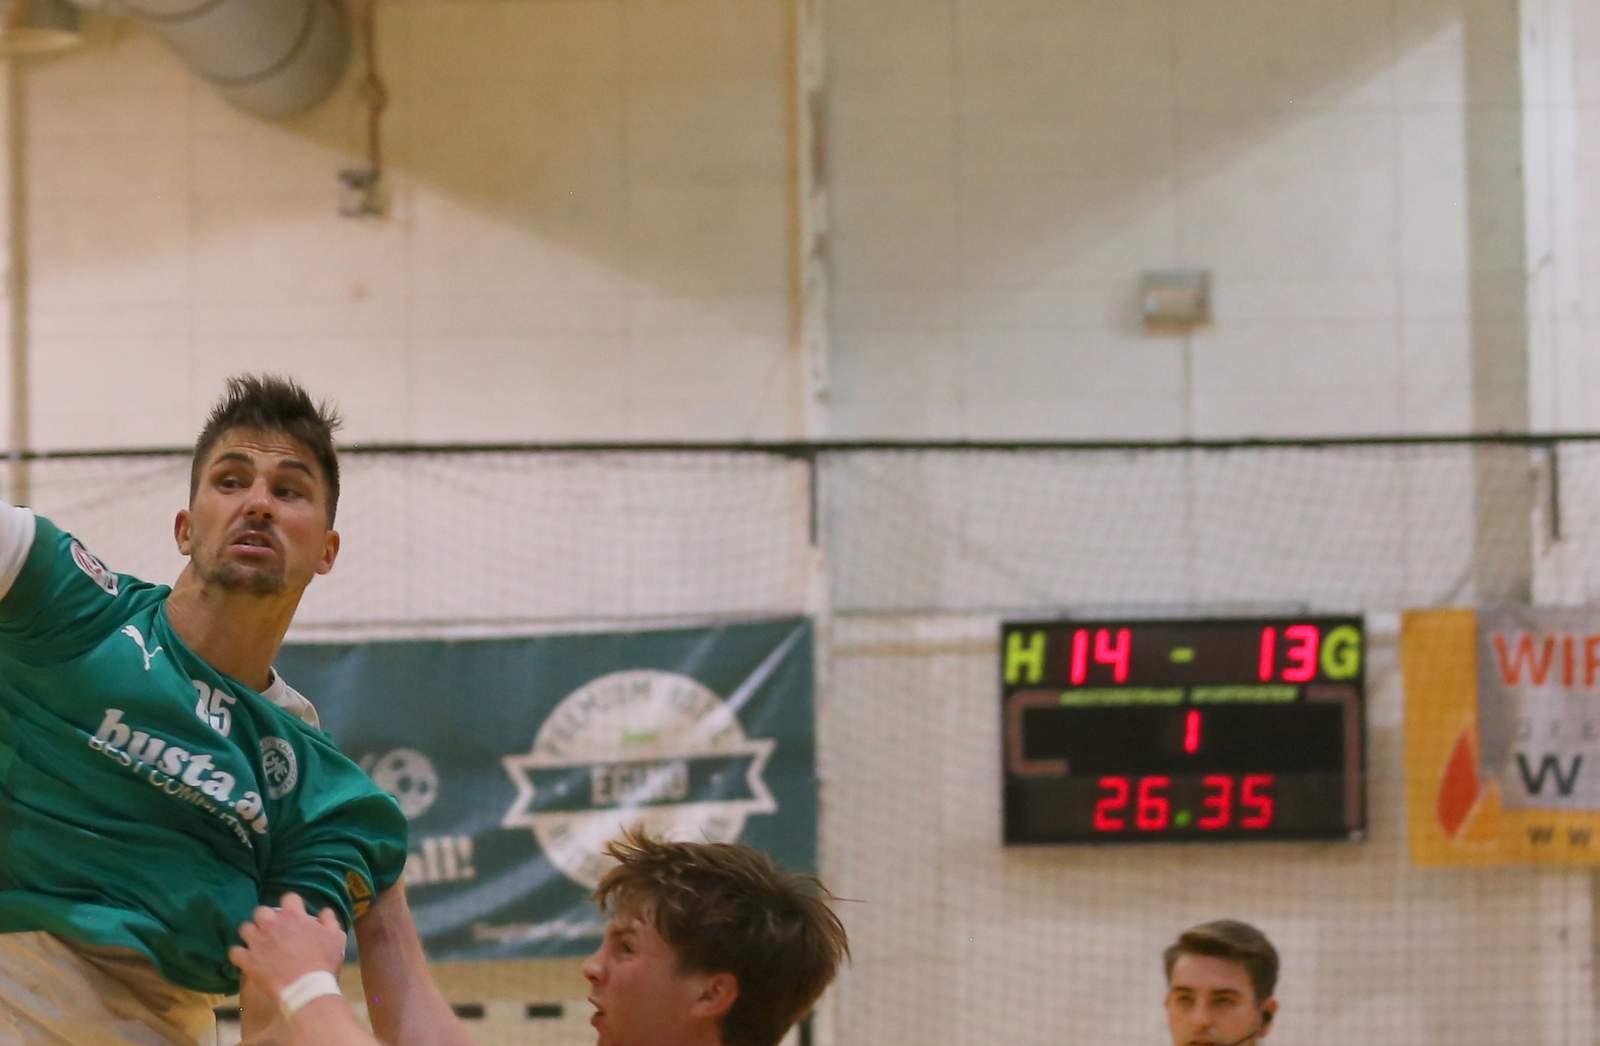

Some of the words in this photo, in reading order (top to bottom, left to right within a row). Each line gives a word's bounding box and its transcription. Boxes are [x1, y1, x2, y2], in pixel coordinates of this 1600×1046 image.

[1005, 631, 1046, 684] H
[1070, 628, 1132, 685] 14
[1258, 624, 1320, 683] 13
[1321, 625, 1361, 679] G
[1184, 709, 1200, 753] 1
